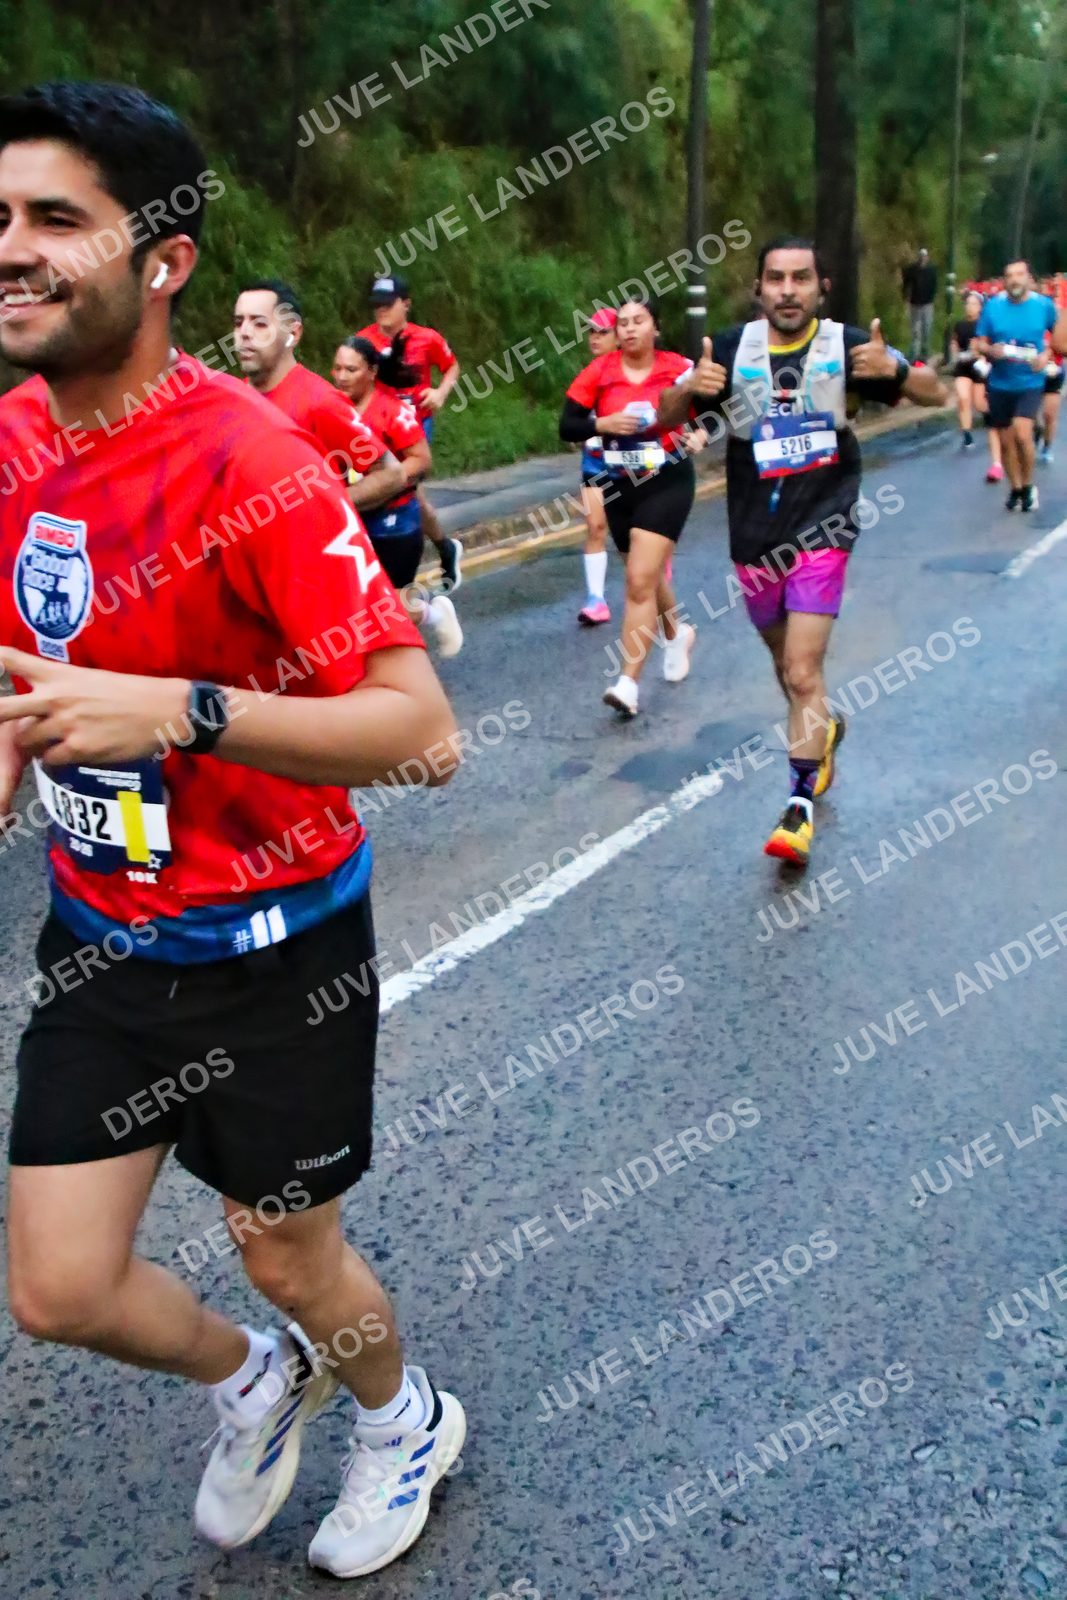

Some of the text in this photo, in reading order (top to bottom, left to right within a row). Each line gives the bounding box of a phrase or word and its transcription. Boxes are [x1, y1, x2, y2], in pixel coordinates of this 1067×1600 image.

[781, 434, 812, 455] 5216
[127, 871, 158, 884] 10K
[295, 1145, 350, 1171] Wilson
